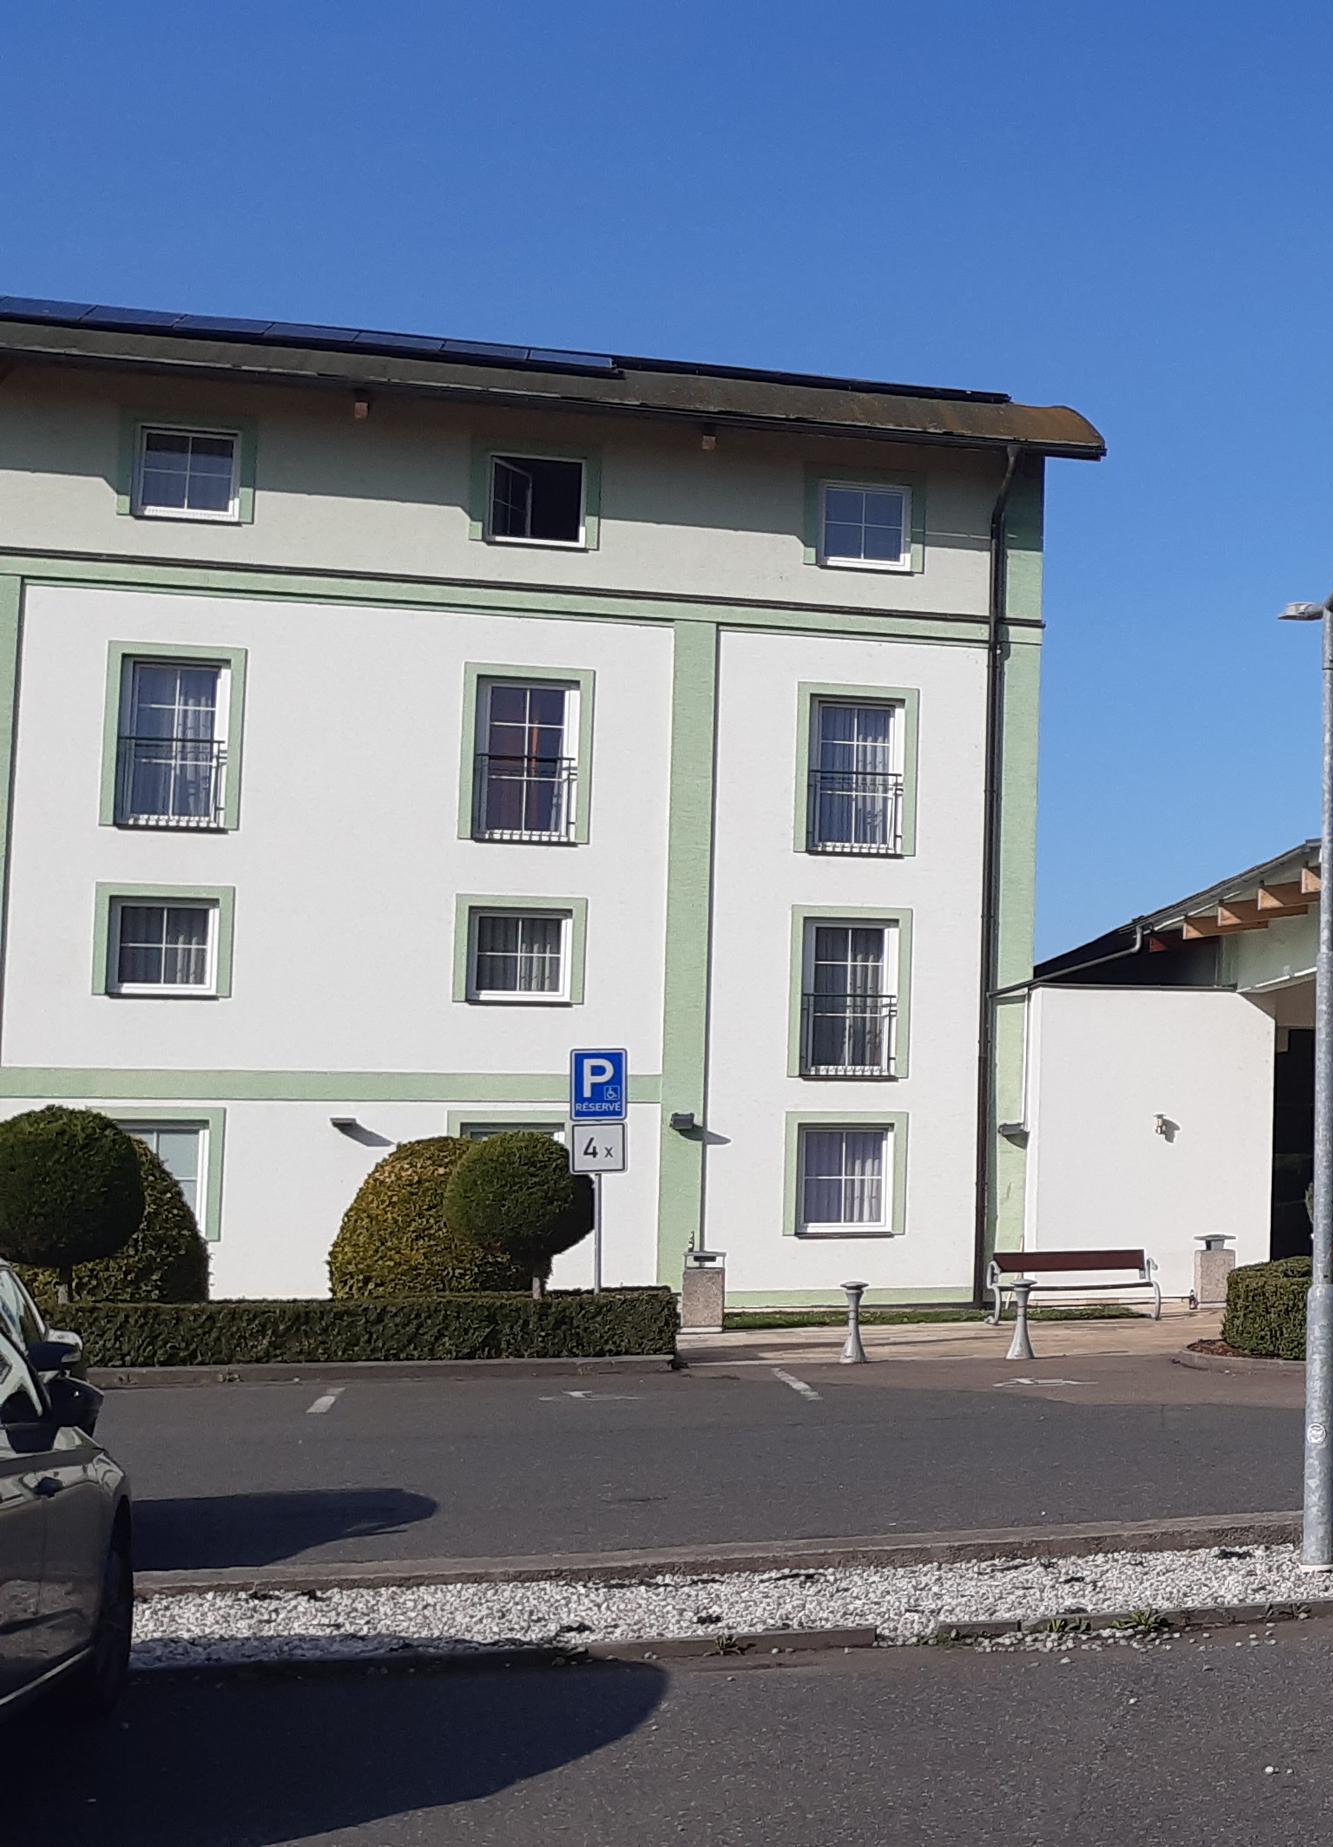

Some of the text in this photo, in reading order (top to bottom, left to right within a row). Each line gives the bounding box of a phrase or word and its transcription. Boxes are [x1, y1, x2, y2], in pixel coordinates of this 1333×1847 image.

[583, 1058, 614, 1098] P
[583, 1137, 614, 1159] 4 x
